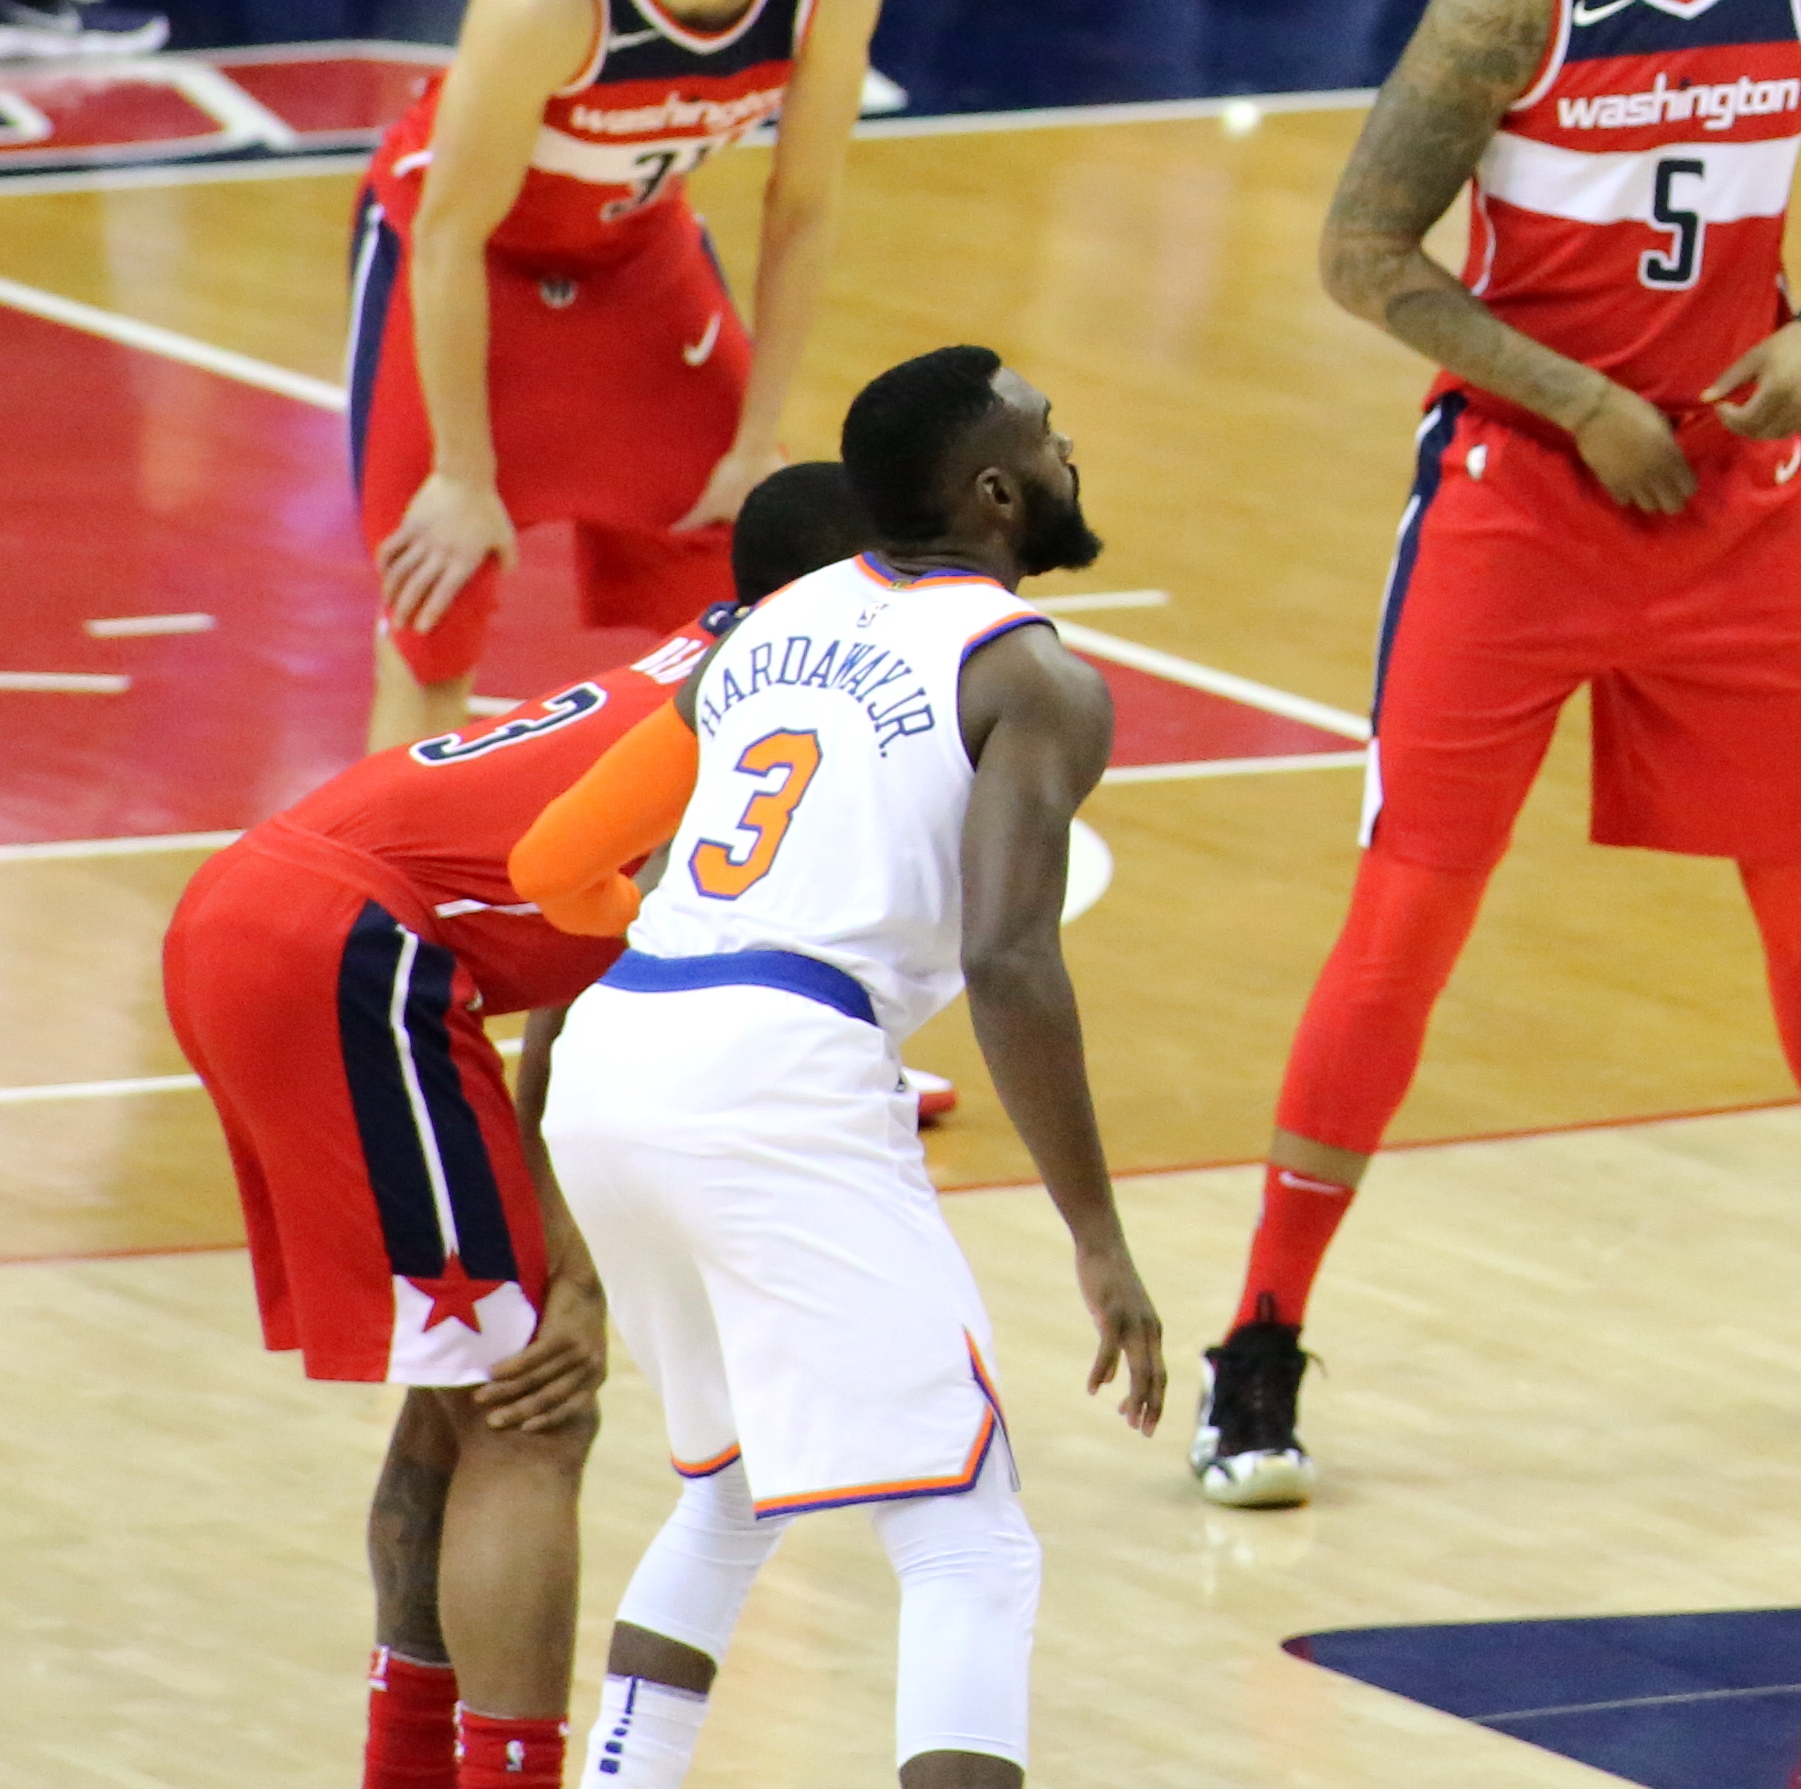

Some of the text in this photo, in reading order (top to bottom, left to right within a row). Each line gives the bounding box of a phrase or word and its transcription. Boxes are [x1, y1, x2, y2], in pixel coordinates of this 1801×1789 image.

[1558, 72, 1801, 130] washington
[1640, 156, 1705, 290] 5
[410, 682, 608, 766] 3
[700, 635, 912, 737] HARDAWAY
[867, 687, 935, 758] JR.
[688, 727, 823, 901] 3
